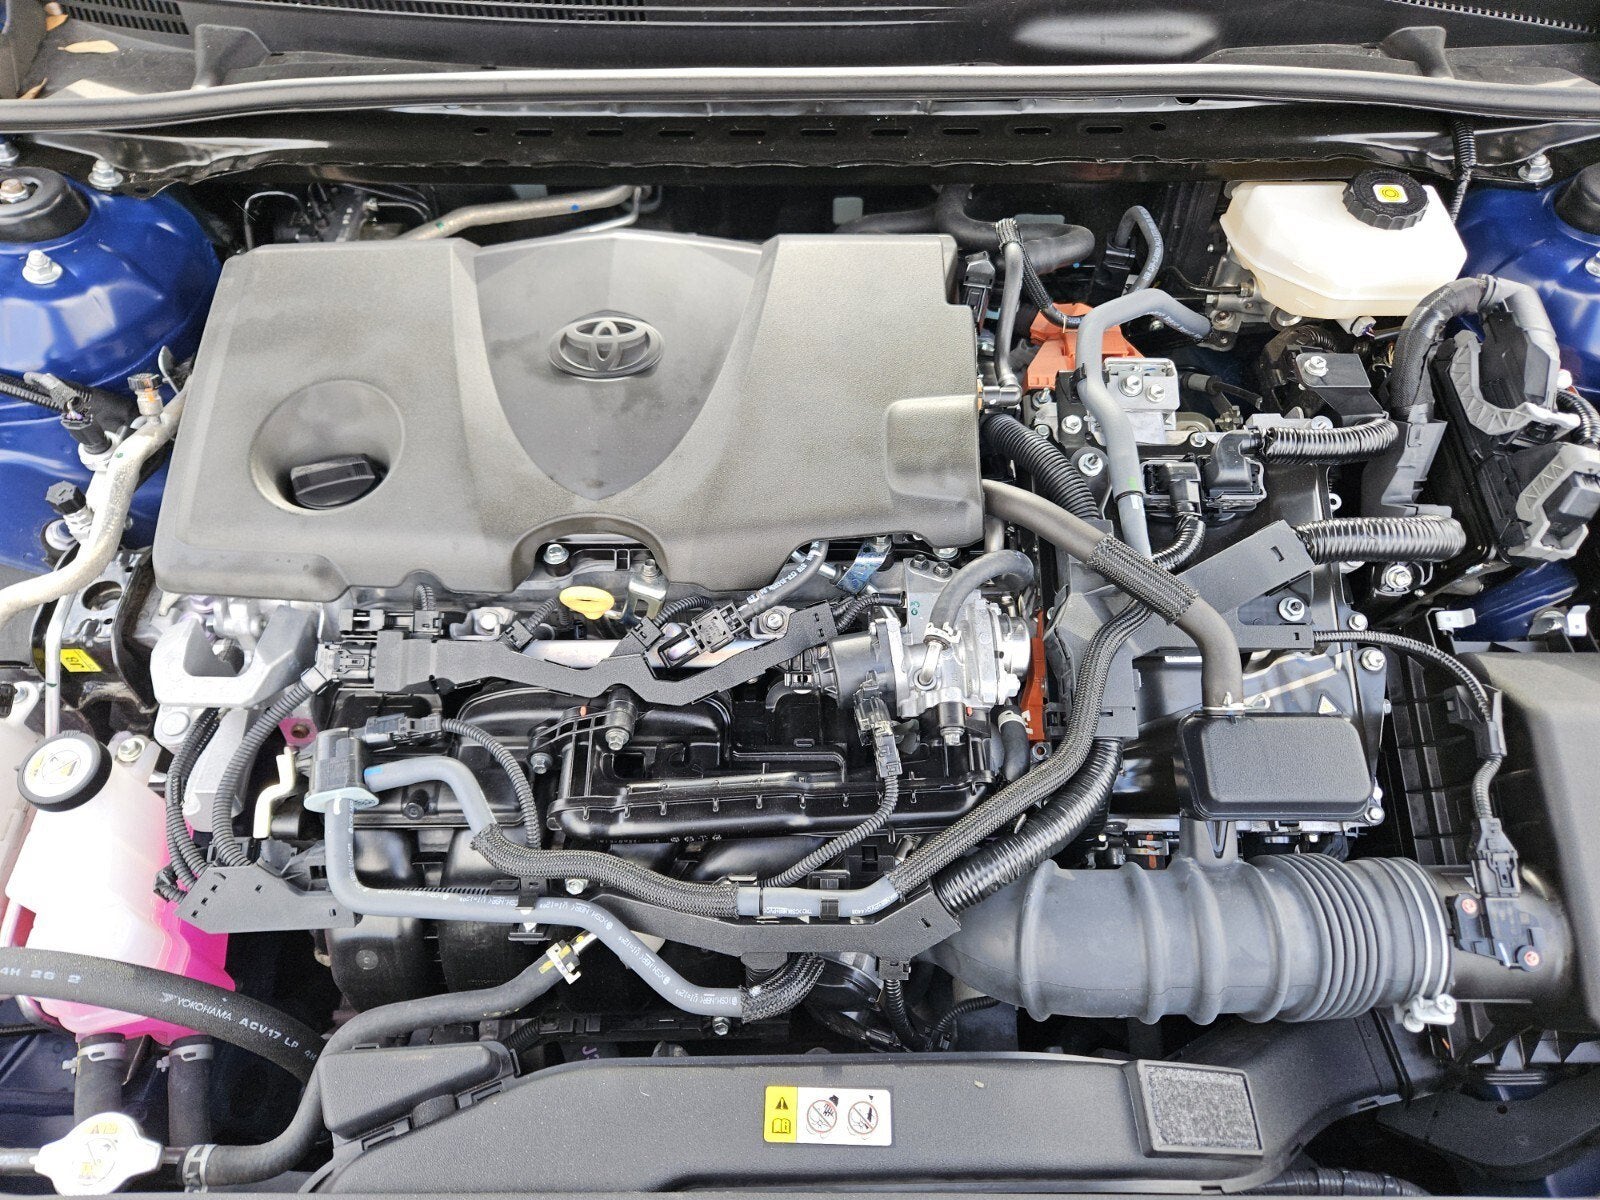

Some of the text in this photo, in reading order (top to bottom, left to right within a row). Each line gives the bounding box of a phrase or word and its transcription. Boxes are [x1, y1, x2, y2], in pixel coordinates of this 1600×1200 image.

[178, 997, 233, 1021] YOKOHAMA
[239, 1018, 282, 1040] ACV17
[284, 1036, 299, 1049] LP
